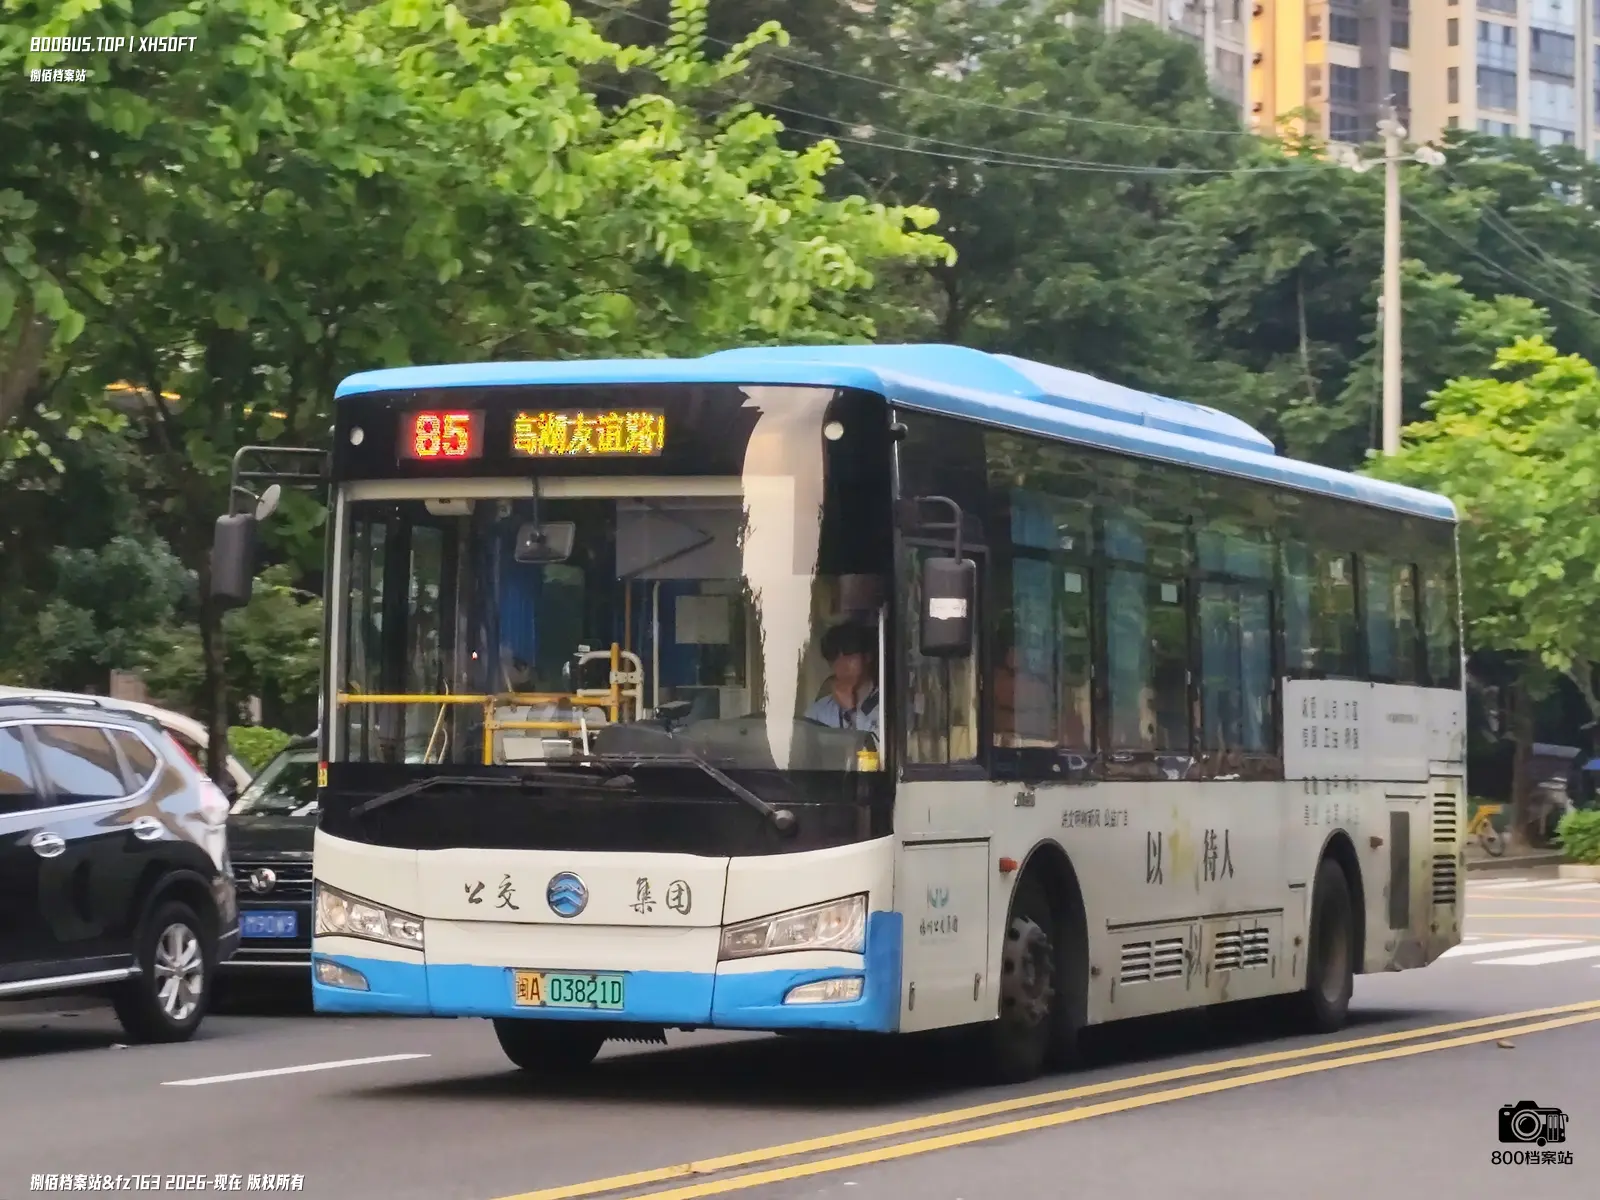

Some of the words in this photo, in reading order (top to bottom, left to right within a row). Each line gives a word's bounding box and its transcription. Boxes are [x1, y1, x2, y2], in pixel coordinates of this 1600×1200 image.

[415, 414, 470, 456] 85
[464, 873, 520, 911] 公交
[629, 876, 692, 916] 集团
[551, 978, 622, 1005] 03821D
